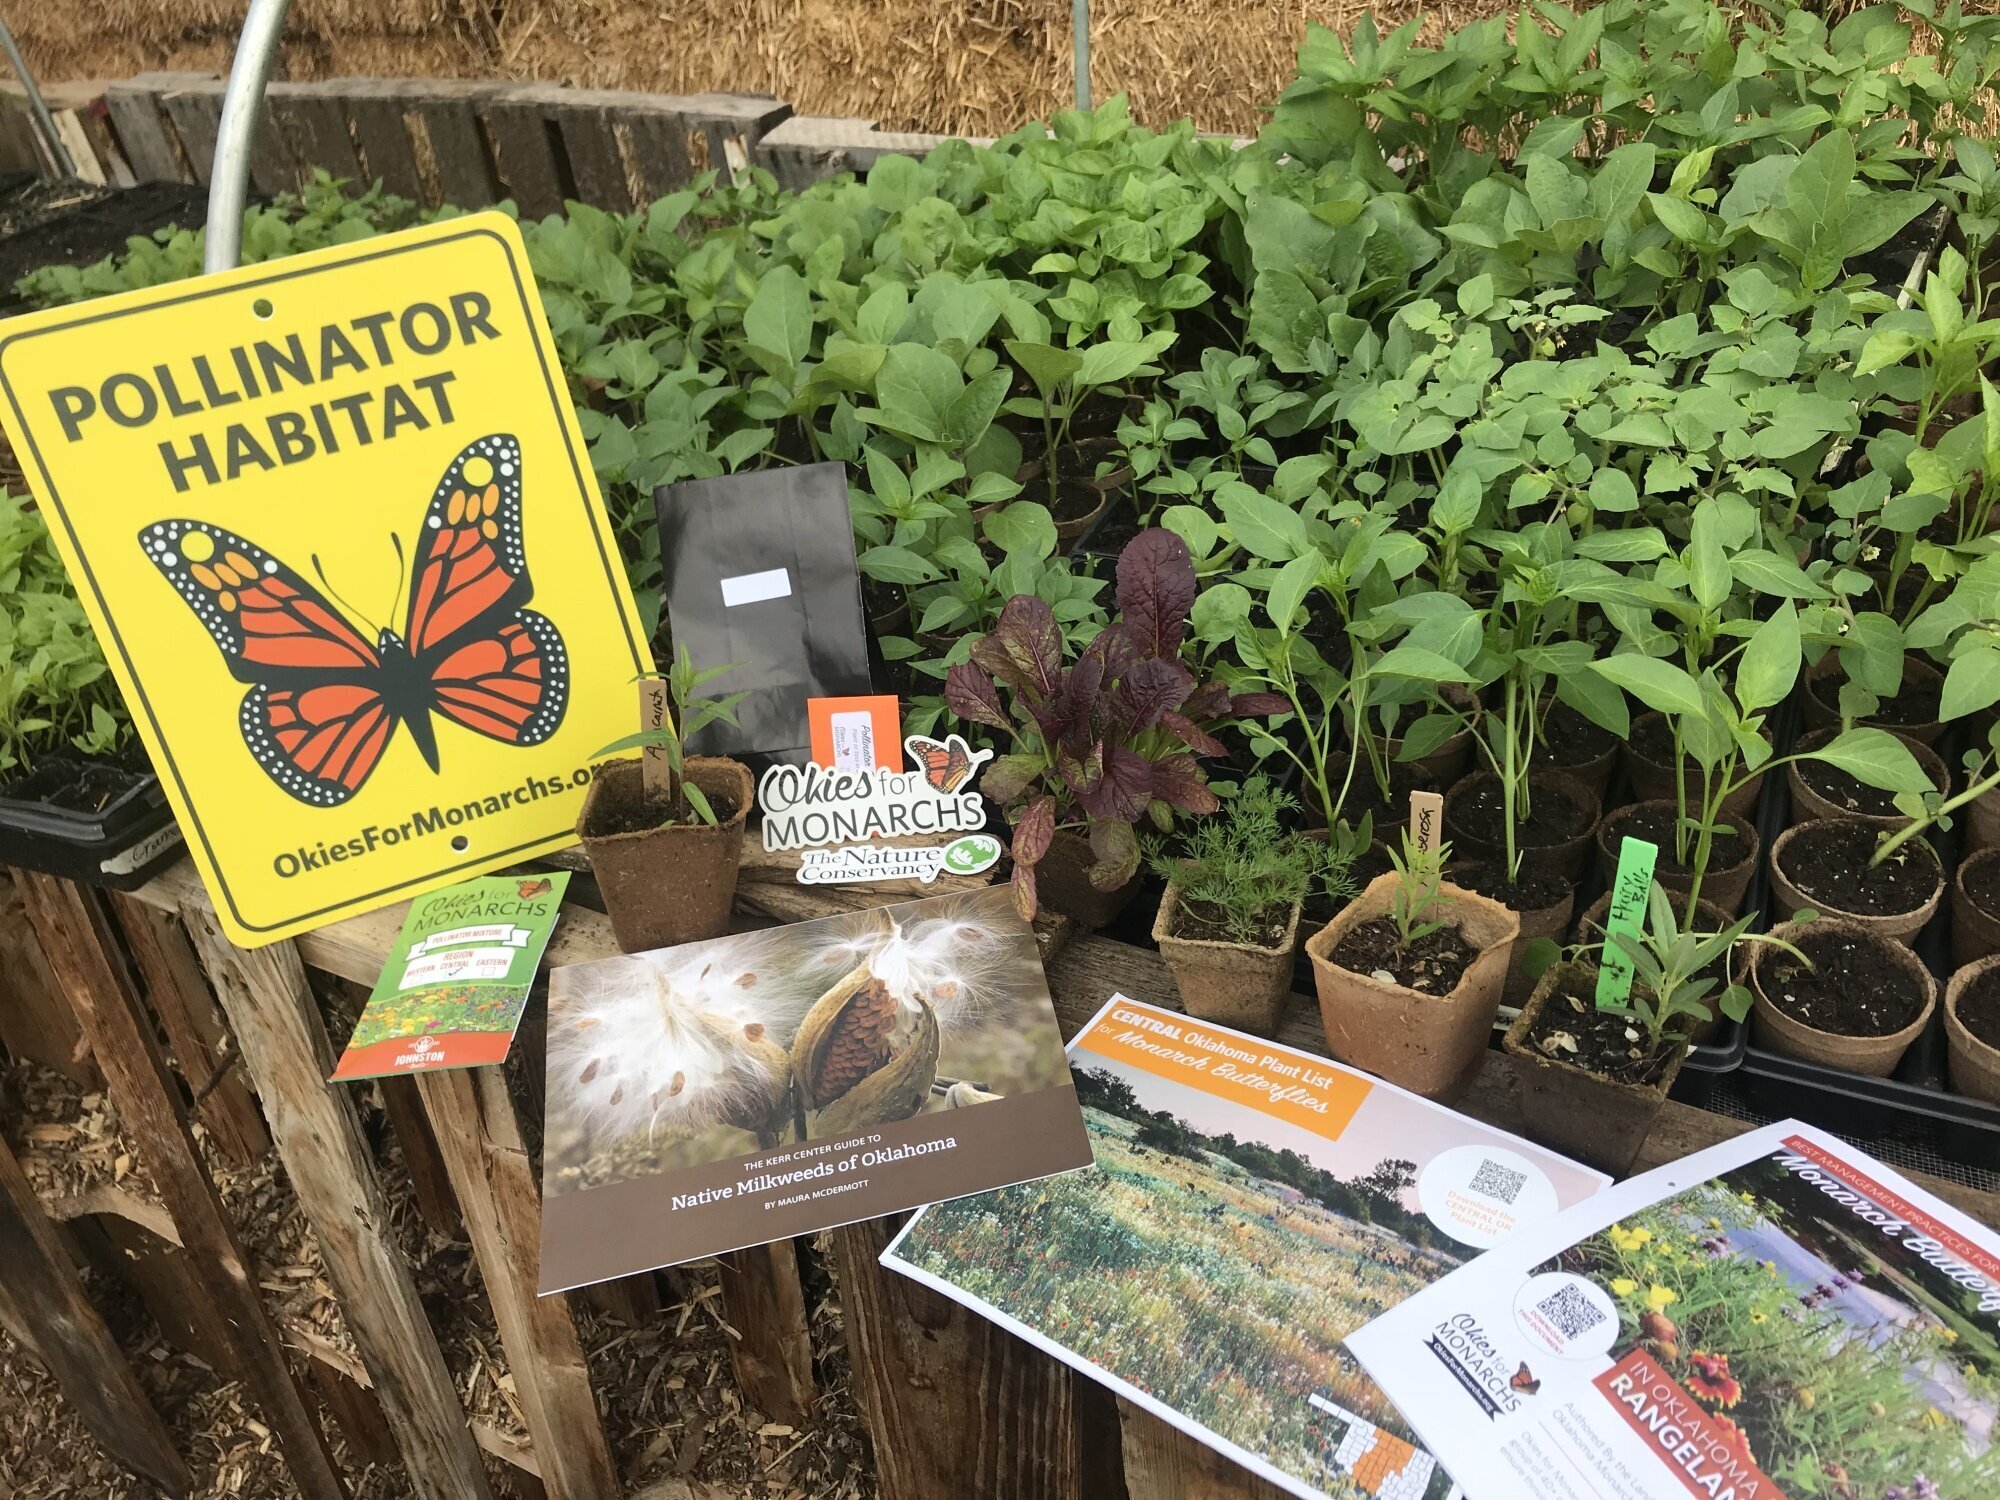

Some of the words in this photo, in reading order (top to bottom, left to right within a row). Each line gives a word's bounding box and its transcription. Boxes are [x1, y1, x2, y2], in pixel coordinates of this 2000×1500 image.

[47, 291, 503, 443] POLLINATOR
[158, 370, 458, 493] HABITAT
[763, 767, 873, 813] Okies
[879, 770, 917, 797] for
[272, 763, 603, 880] OkiesForMonarchs.or
[766, 796, 982, 848] MONARCHS
[802, 863, 940, 882] Conservancy
[806, 853, 842, 866] The
[844, 848, 941, 866] Nature
[413, 902, 548, 932] MONARCHS
[422, 890, 485, 918] Okies
[486, 889, 514, 901] for
[432, 931, 473, 944] POLLINATOR
[472, 928, 503, 938] MIXTURE
[443, 950, 475, 961] REGION
[406, 965, 437, 977] WESTERN
[440, 960, 470, 970] CENTRAL
[476, 959, 508, 967] EASTERN
[394, 1051, 446, 1067] JOHNSTON
[1093, 1023, 1115, 1035] for
[1112, 1030, 1210, 1071] Monarch
[1210, 1062, 1328, 1114] Butterflies
[1111, 1009, 1181, 1041] CENTRAL
[1183, 1032, 1257, 1065] Oklahoma
[1258, 1055, 1301, 1079] Plant
[1301, 1068, 1334, 1091] List
[671, 1184, 733, 1211] Native
[736, 1163, 834, 1197] Milkweeds
[838, 1155, 858, 1173] of
[861, 1136, 957, 1167] Oklahoma
[744, 1161, 765, 1172] THE
[766, 1155, 792, 1168] KERR
[793, 1145, 832, 1160] CENTER
[833, 1138, 865, 1153] GUIDE
[866, 1134, 882, 1144] TO
[764, 1202, 775, 1211] BY
[777, 1194, 811, 1208] MAURA
[812, 1180, 869, 1198] MCDERMOTT
[1445, 1199, 1494, 1226] CENTRAL
[1495, 1218, 1514, 1233] OK
[1447, 1190, 1500, 1218] Download
[1499, 1209, 1517, 1224] the
[1772, 1155, 1911, 1237] Monarch
[1790, 1140, 1819, 1162] BEST
[1818, 1154, 1905, 1213] MANAGEMENT
[1904, 1209, 1973, 1256] PRACTICES
[1972, 1250, 2000, 1275] FOR
[1449, 1211, 1477, 1229] Plant
[1477, 1223, 1498, 1237] List
[1451, 1313, 1497, 1359] Okies
[1492, 1356, 1511, 1377] for
[1518, 1308, 1532, 1323] THIS
[1530, 1322, 1565, 1355] DOCUMENT
[1530, 1310, 1565, 1345] DOWNLOAD
[1435, 1321, 1522, 1413] MONARCHS
[1552, 1409, 1596, 1462] Oklahoma
[1564, 1402, 1605, 1449] Authored
[1602, 1447, 1617, 1462] By
[1615, 1461, 1632, 1480] the
[1629, 1361, 1656, 1385] IN
[1652, 1384, 1758, 1500] OKLAHOMA
